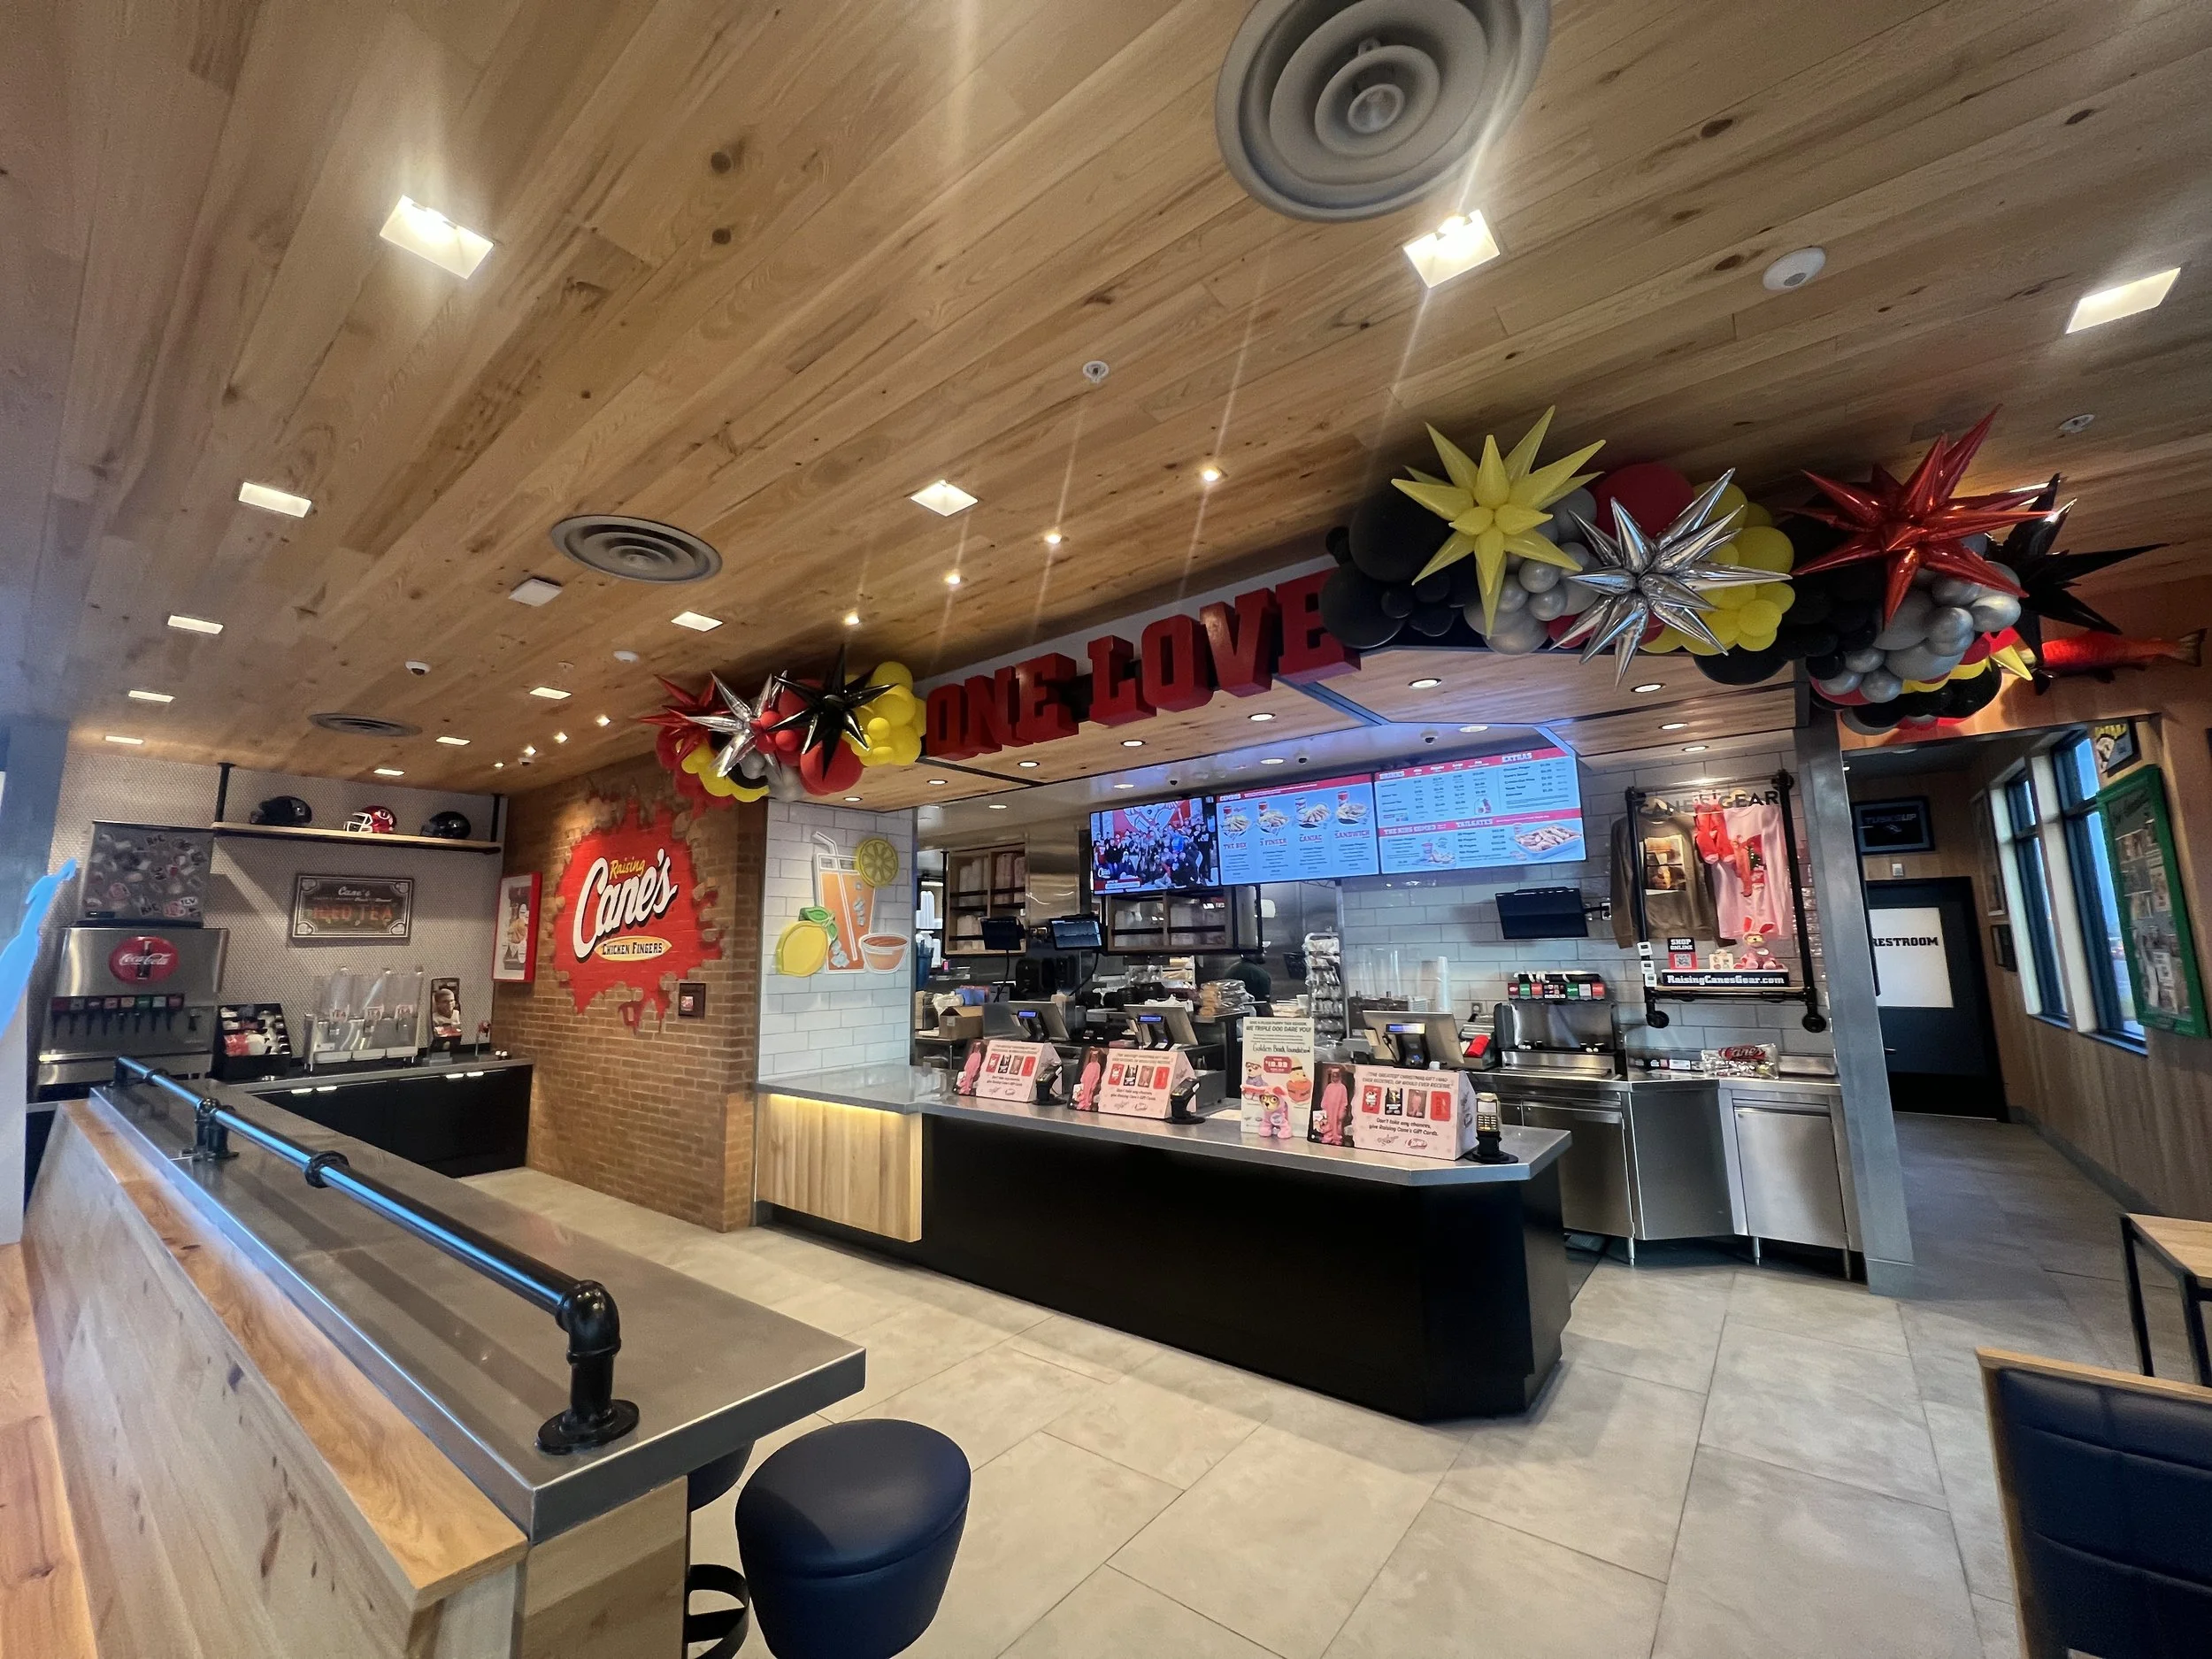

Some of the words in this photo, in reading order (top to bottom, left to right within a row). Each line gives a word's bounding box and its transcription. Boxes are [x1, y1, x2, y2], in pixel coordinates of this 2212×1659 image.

[926, 652, 1079, 761] ONE
[1087, 567, 1361, 726] LOVE
[1502, 753, 1532, 762] EXTRAS
[1718, 790, 1779, 809] GEAR
[1334, 830, 1371, 839] SANDWICH
[610, 856, 645, 879] Raising
[338, 886, 370, 896] Cane's
[573, 849, 678, 957] Cane's
[603, 943, 630, 955] CHICKEN
[632, 941, 662, 954] FINGERS
[119, 953, 171, 965] Coca-Cola
[1667, 975, 1785, 987] RaisingCanesGear.com
